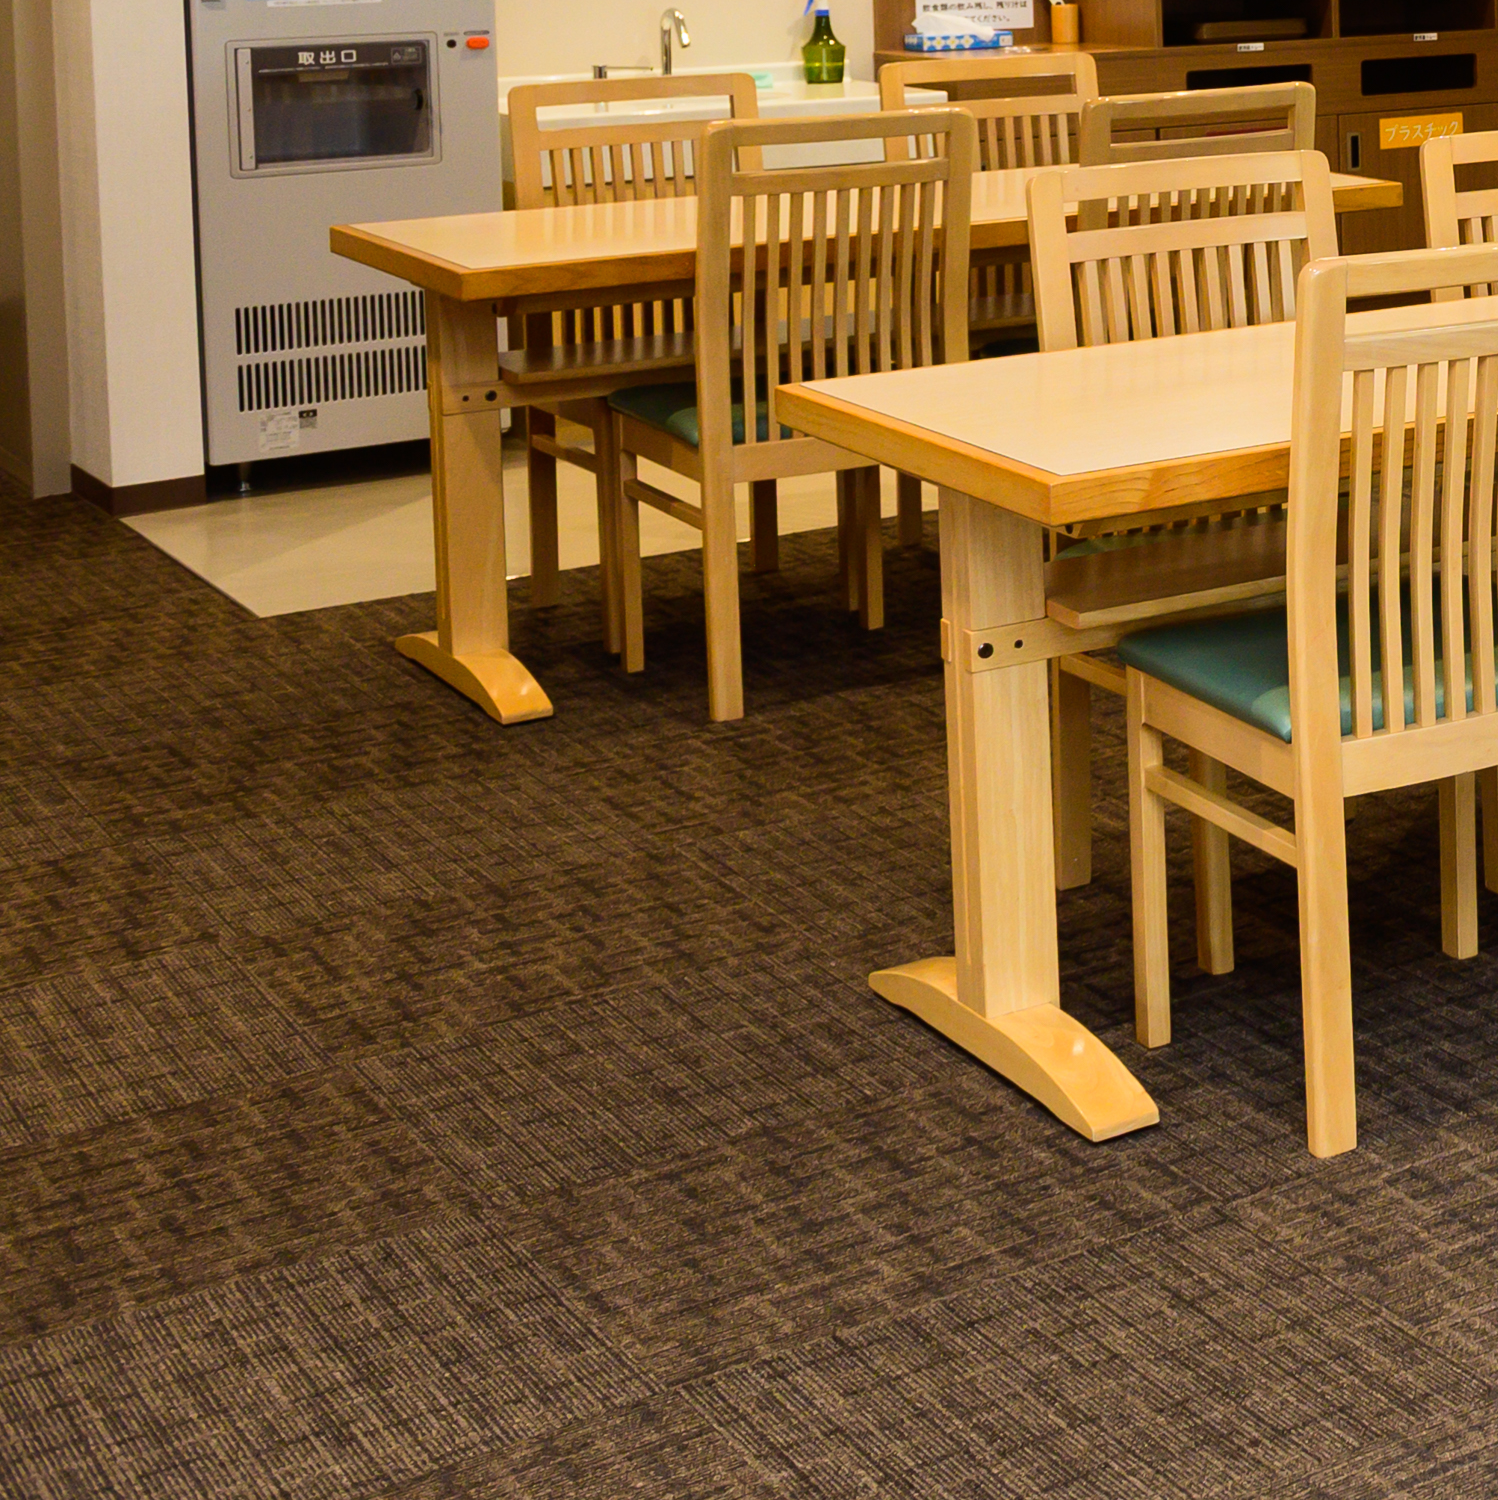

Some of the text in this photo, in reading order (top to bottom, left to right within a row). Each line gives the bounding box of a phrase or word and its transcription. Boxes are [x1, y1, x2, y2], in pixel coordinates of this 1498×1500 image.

[298, 50, 356, 65] 取出口
[1384, 121, 1458, 142] プラスチック
